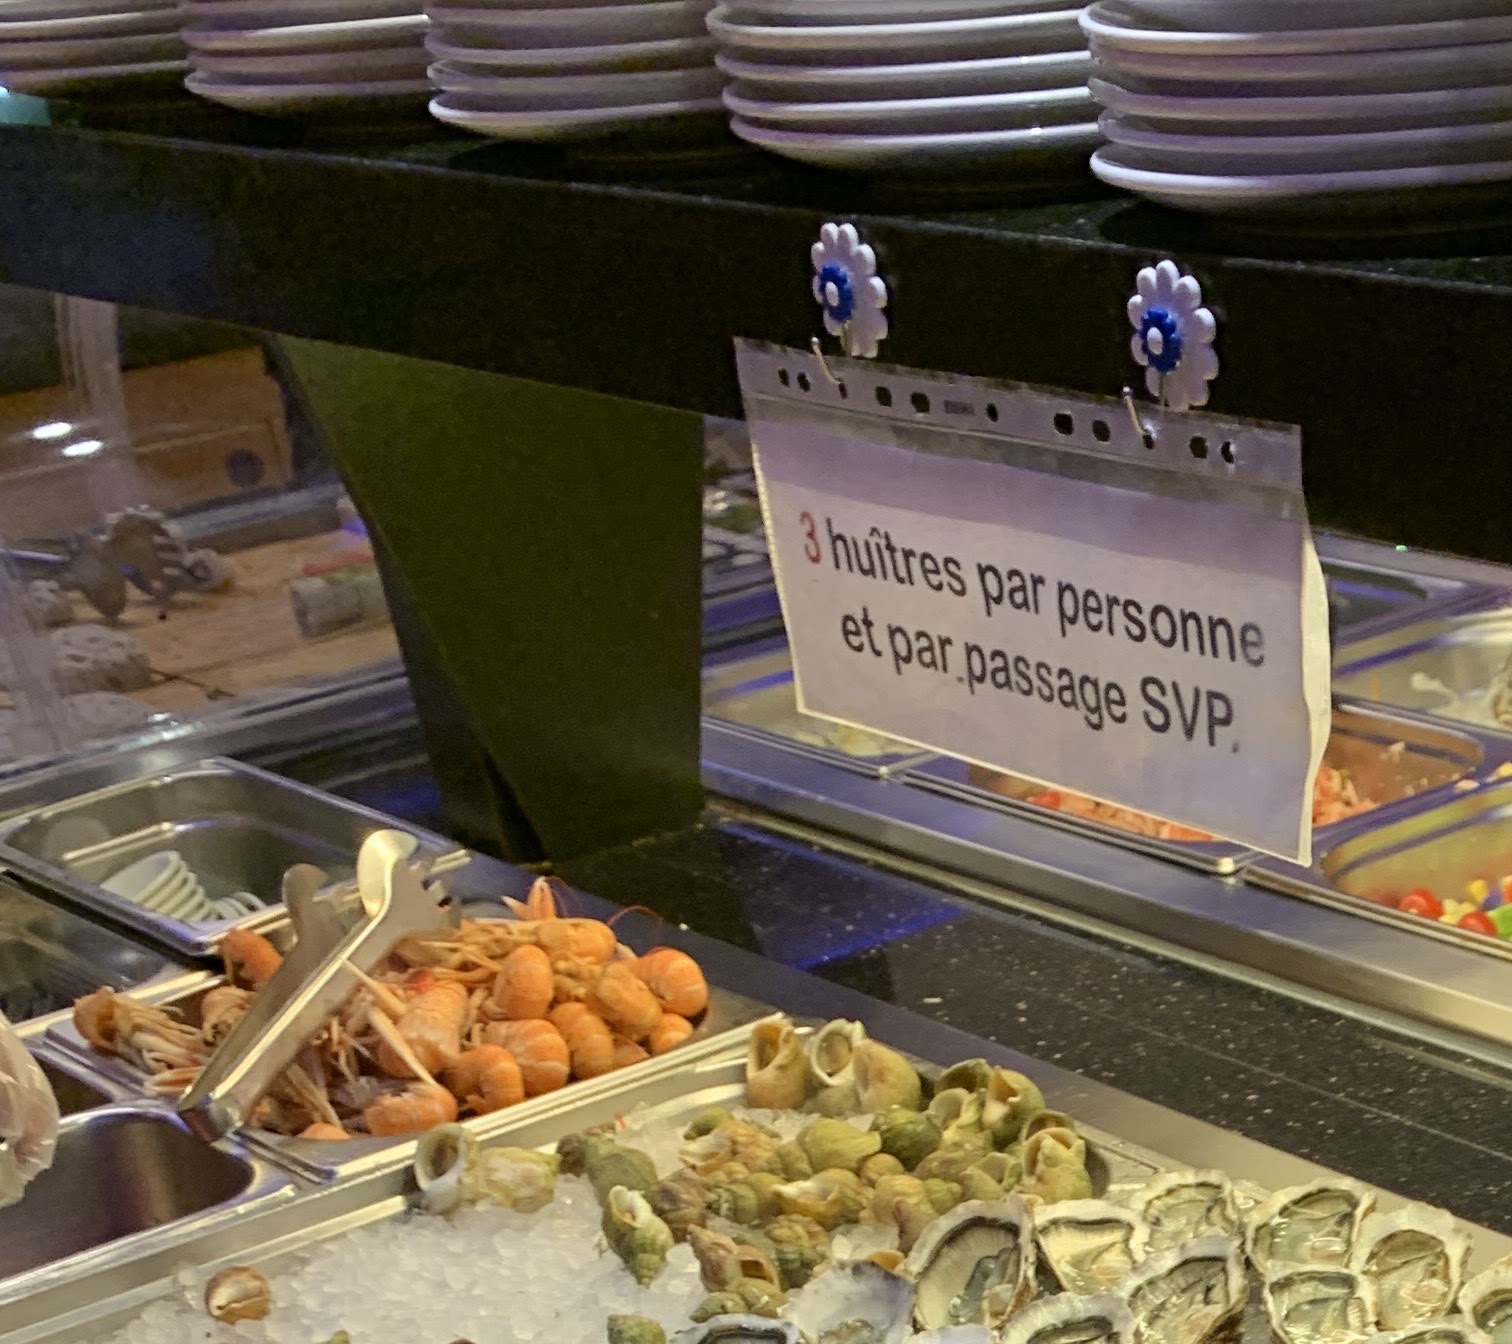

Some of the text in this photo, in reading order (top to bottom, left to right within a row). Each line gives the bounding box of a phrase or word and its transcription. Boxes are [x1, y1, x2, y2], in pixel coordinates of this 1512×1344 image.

[800, 511, 1265, 668] 3 huîtres par personne
[841, 605, 882, 657] et
[887, 623, 953, 675] par
[964, 641, 1127, 731] passage
